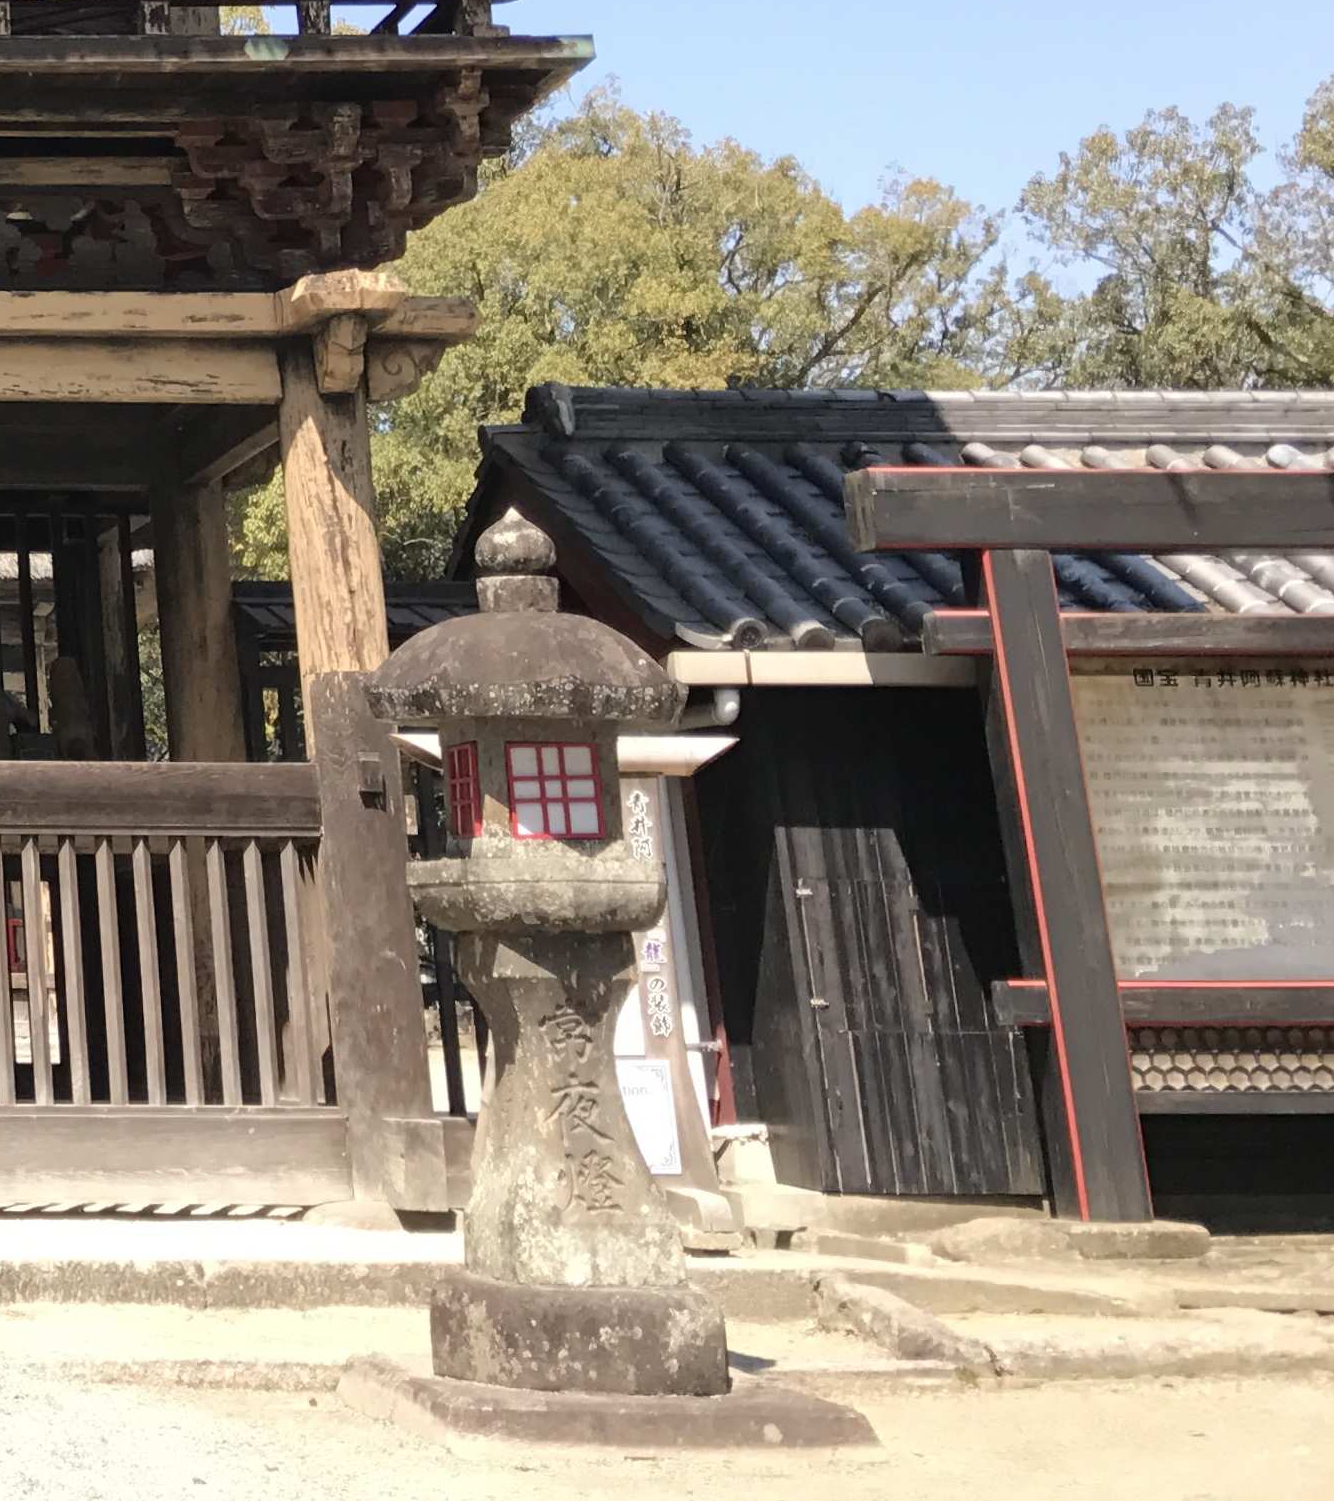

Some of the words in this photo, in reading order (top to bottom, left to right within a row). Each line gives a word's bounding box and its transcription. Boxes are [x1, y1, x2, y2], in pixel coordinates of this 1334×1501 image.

[1133, 668, 1179, 688] 国宝
[1193, 668, 1334, 689] 青井阿蘇神社
